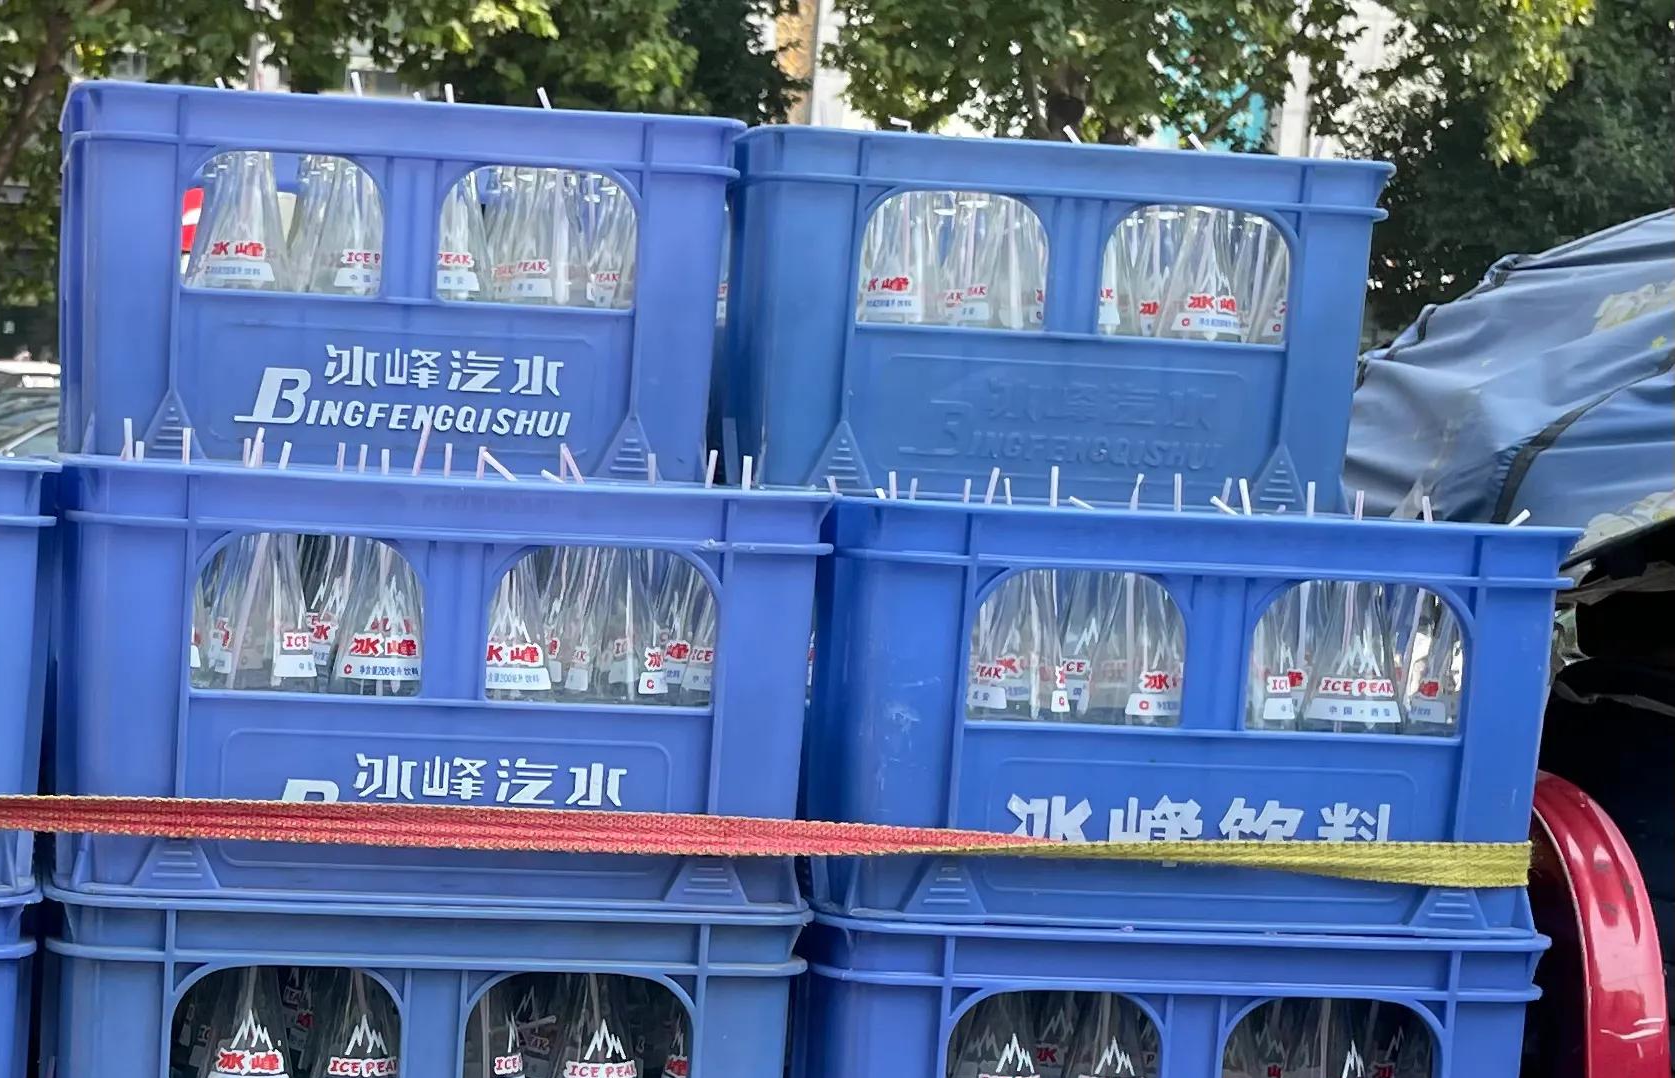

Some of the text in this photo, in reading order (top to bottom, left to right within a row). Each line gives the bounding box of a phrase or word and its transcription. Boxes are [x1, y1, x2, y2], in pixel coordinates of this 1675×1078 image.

[324, 343, 565, 397] 冰峰汽水
[234, 367, 572, 437] BINGFENGQISHUI
[351, 637, 416, 656] 冰峰
[1322, 679, 1353, 691] ICE
[353, 752, 627, 807] 冰峰汽水
[218, 1052, 279, 1071] 冰峰
[330, 1057, 396, 1074] ICE PEA
[495, 1056, 517, 1070] ICE
[568, 1065, 600, 1077] ICE
